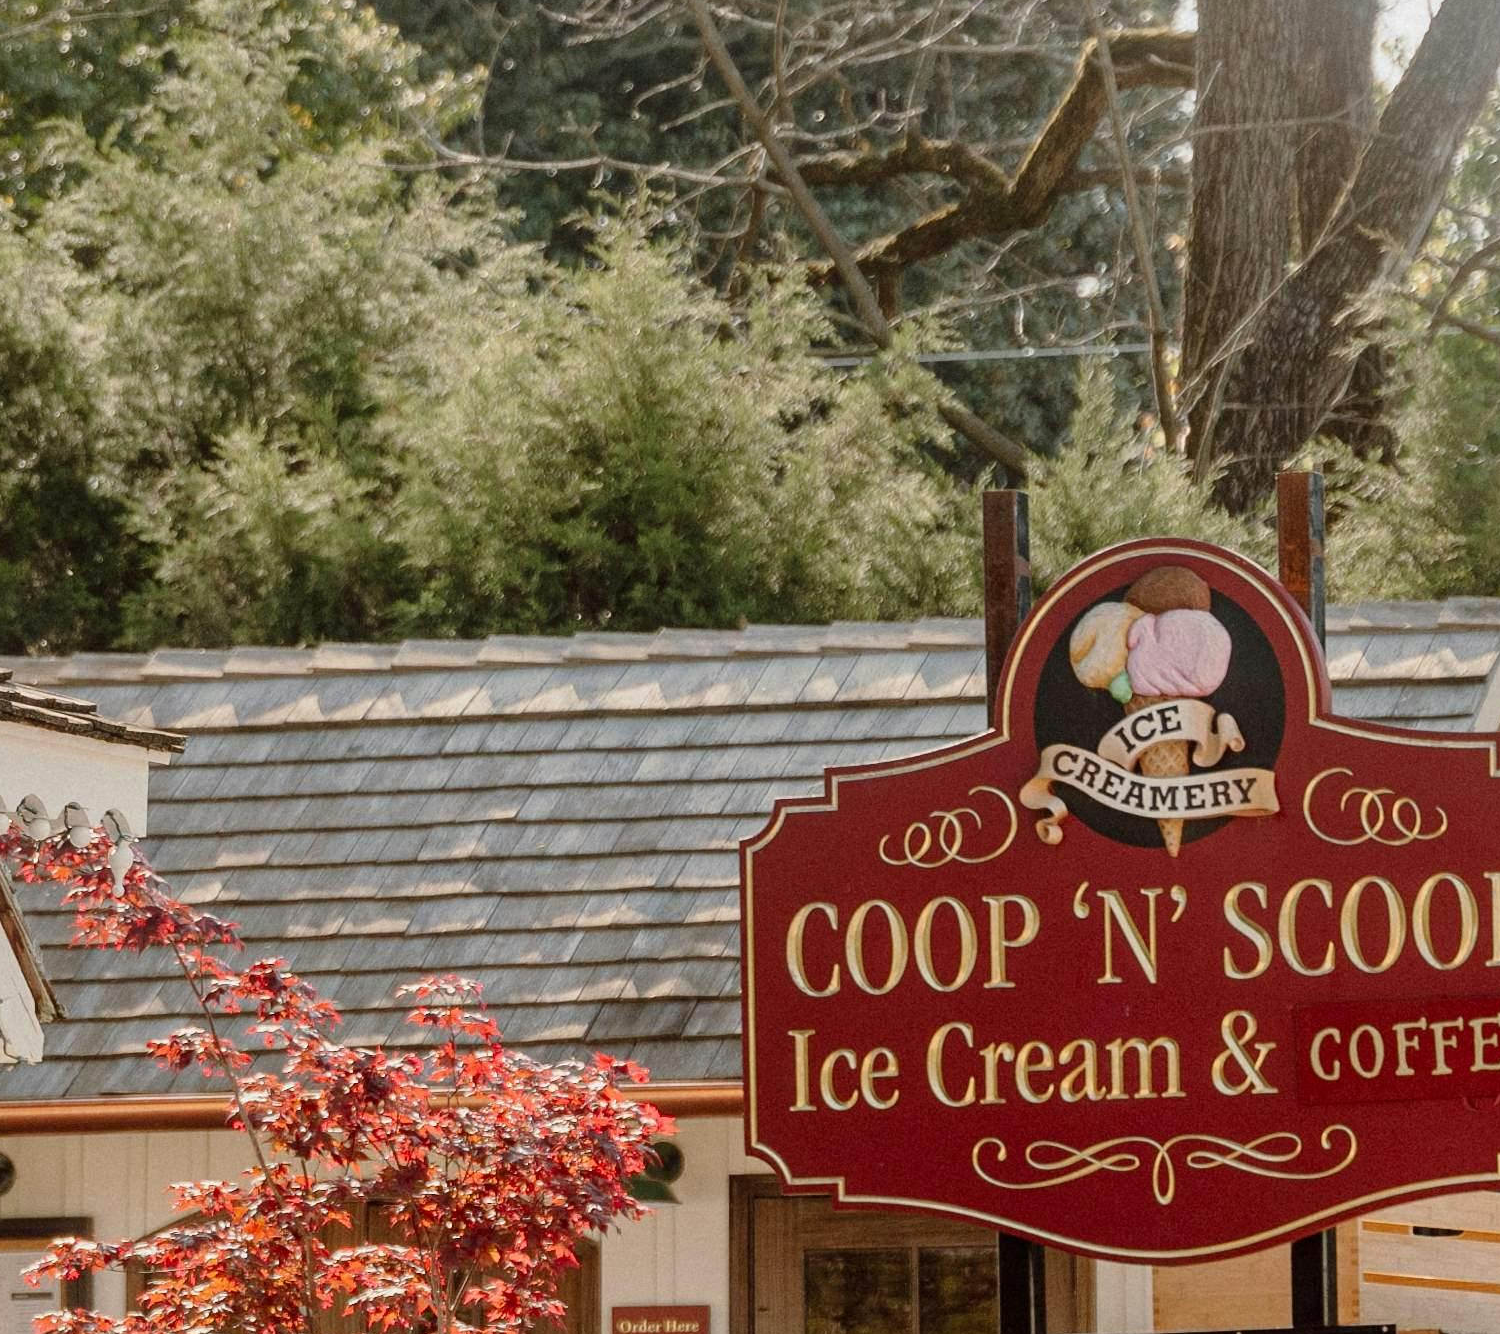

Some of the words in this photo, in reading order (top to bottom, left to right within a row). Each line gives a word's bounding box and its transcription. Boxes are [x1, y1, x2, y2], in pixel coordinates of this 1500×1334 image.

[1114, 705, 1183, 754] ICE
[1052, 750, 1257, 812] CREAMERY
[785, 894, 1041, 999] COOP
[787, 1028, 900, 1113] Ice
[925, 1021, 1188, 1108] Cream
[1211, 1009, 1279, 1097] &
[619, 1318, 662, 1334] Order
[665, 1319, 700, 1333] Here
